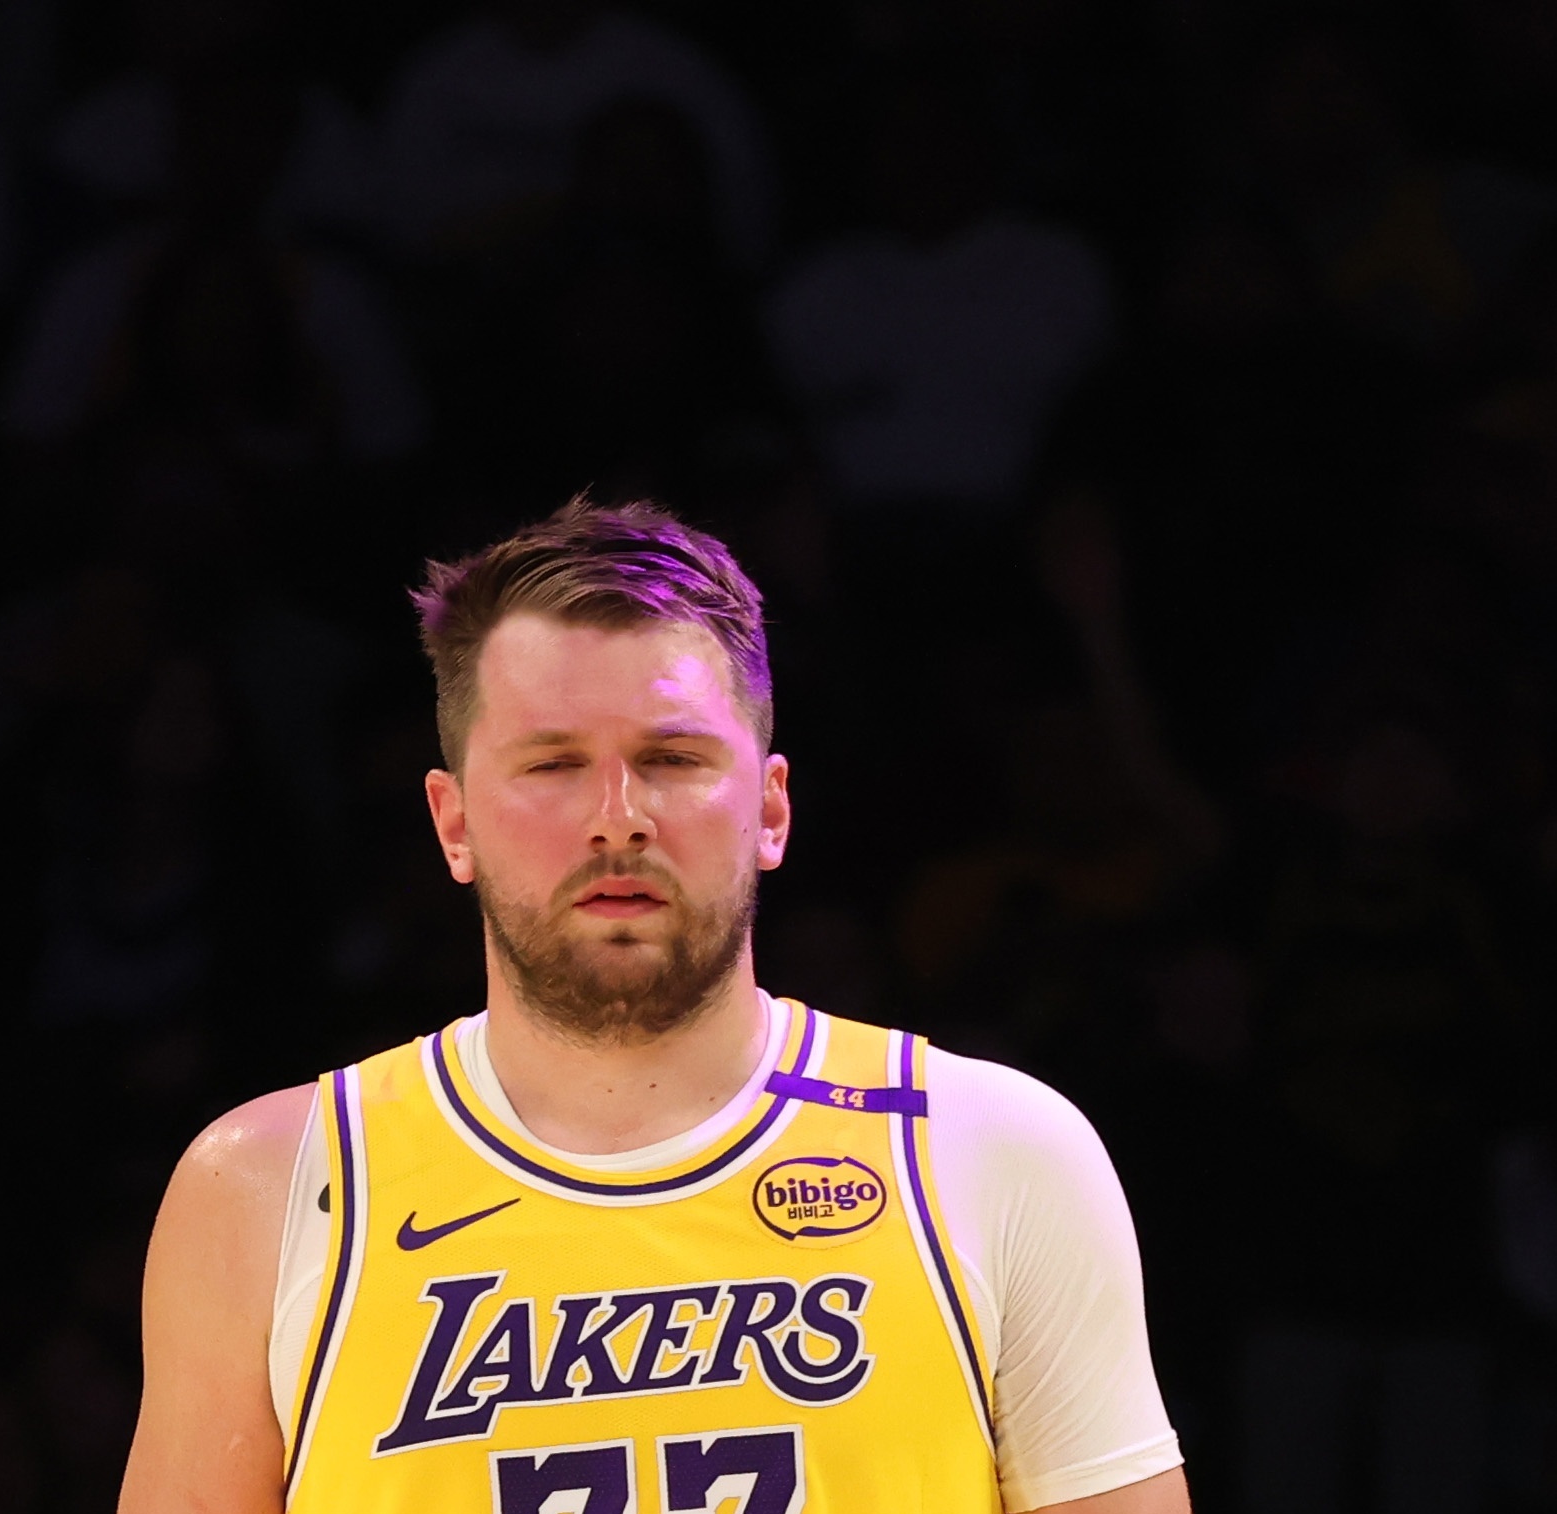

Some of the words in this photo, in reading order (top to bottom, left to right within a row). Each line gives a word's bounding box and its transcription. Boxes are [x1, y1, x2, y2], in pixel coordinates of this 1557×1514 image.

[828, 1087, 865, 1108] 44
[764, 1177, 878, 1211] bibigo
[787, 1204, 836, 1221] 비비고
[371, 1270, 874, 1458] LAKERS
